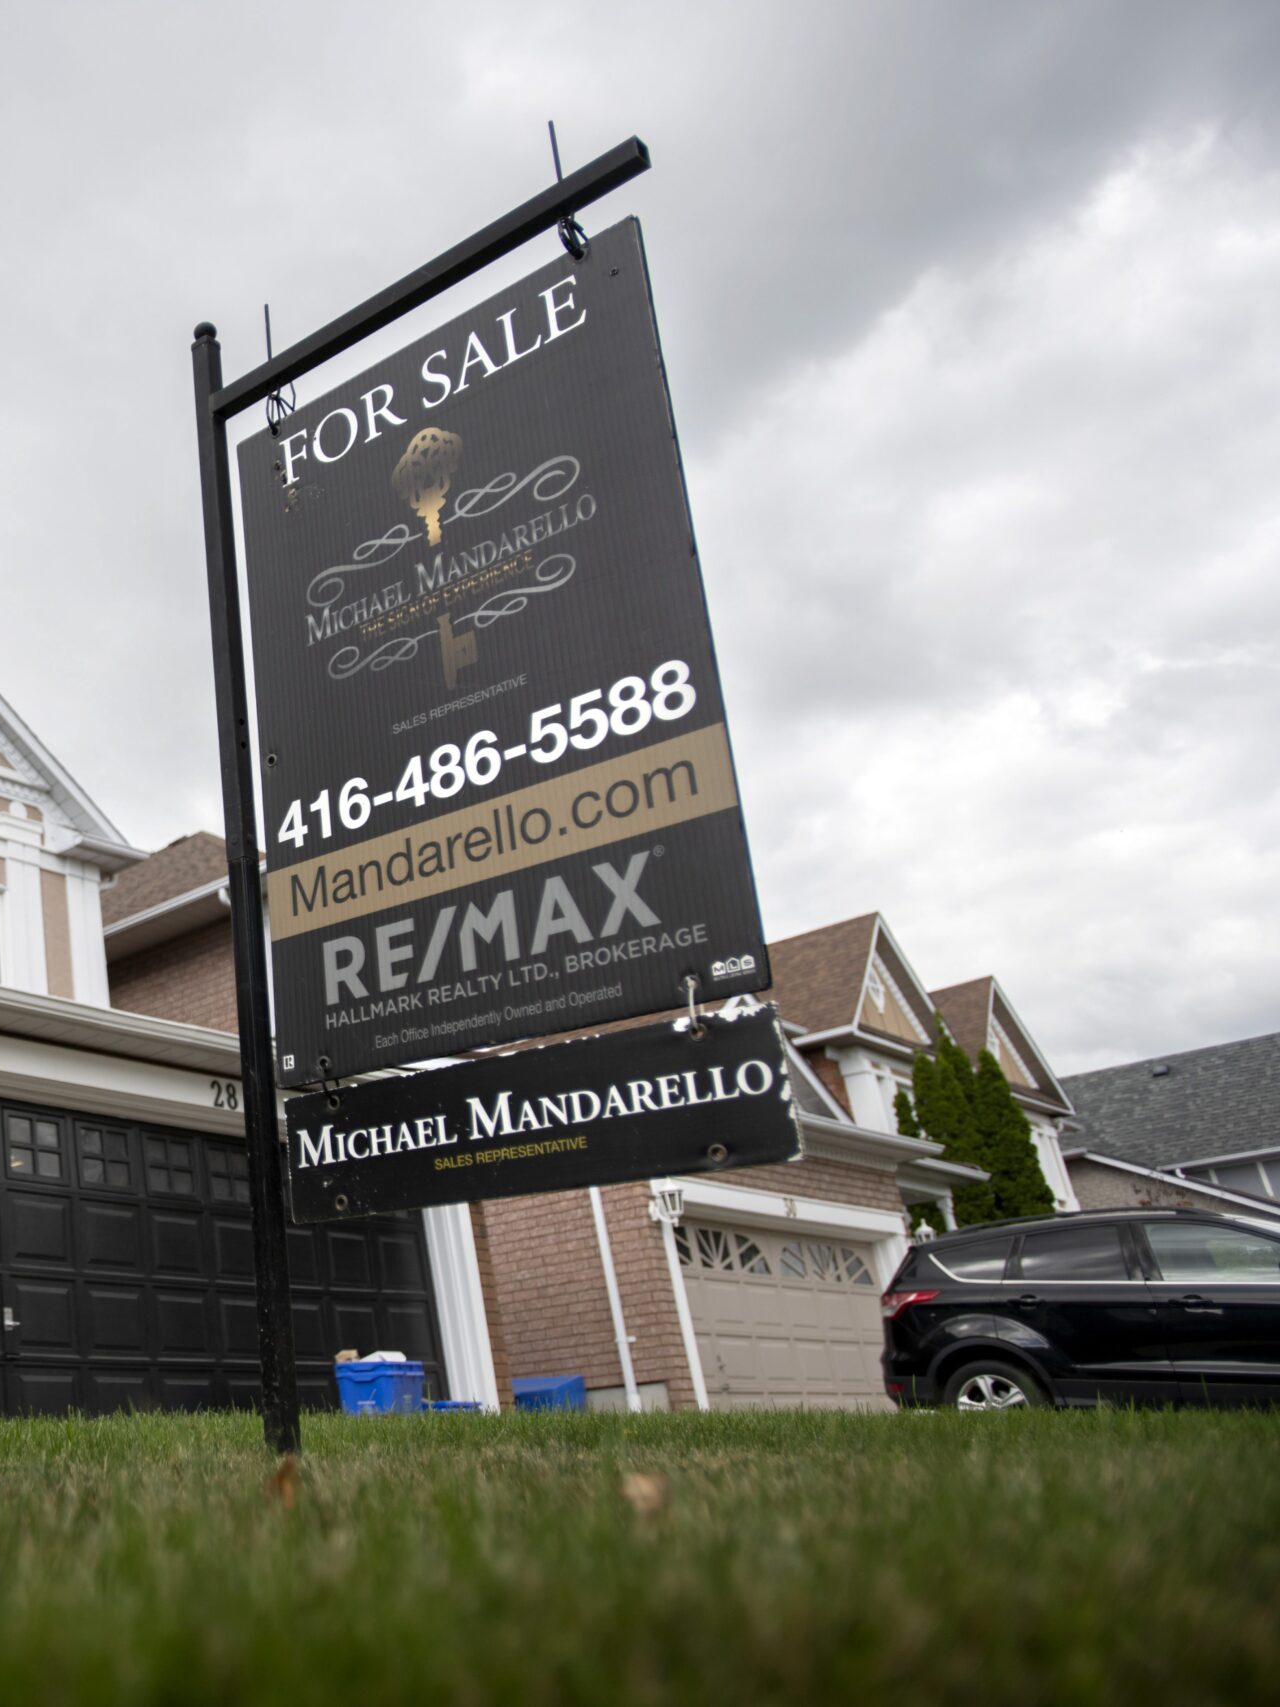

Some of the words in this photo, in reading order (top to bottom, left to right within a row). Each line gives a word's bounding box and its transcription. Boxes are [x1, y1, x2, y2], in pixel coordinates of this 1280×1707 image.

[279, 383, 408, 488] FOR
[420, 275, 587, 409] SALE
[305, 580, 412, 647] MICHAEL
[414, 494, 597, 595] MANDARELLO
[359, 621, 386, 642] THE
[387, 603, 421, 633] SIGN
[443, 550, 535, 606] EXPERIENCE
[277, 660, 697, 848] 416-486-5588
[393, 713, 427, 734] SALES
[430, 673, 528, 720] REPRESENTATIVE
[289, 758, 699, 917] Mandarello.com
[322, 851, 662, 1006] RE/MAX
[326, 992, 423, 1030] HALLMARK
[428, 971, 502, 1006] REALTY
[508, 963, 560, 986] LTD.,
[565, 923, 709, 973] BROKERAGE
[375, 1034, 399, 1049] Each
[401, 1027, 429, 1043] Office
[431, 1007, 503, 1036] Independently
[505, 1004, 543, 1021] Owned
[545, 995, 567, 1012] and
[569, 982, 623, 1007] Operated
[210, 1080, 238, 1110] 28
[296, 1115, 458, 1169] MICHAEL
[466, 1059, 773, 1141] MANDARELLO
[434, 1155, 473, 1171] SALES
[476, 1136, 587, 1165] REPRESENTATIVE
